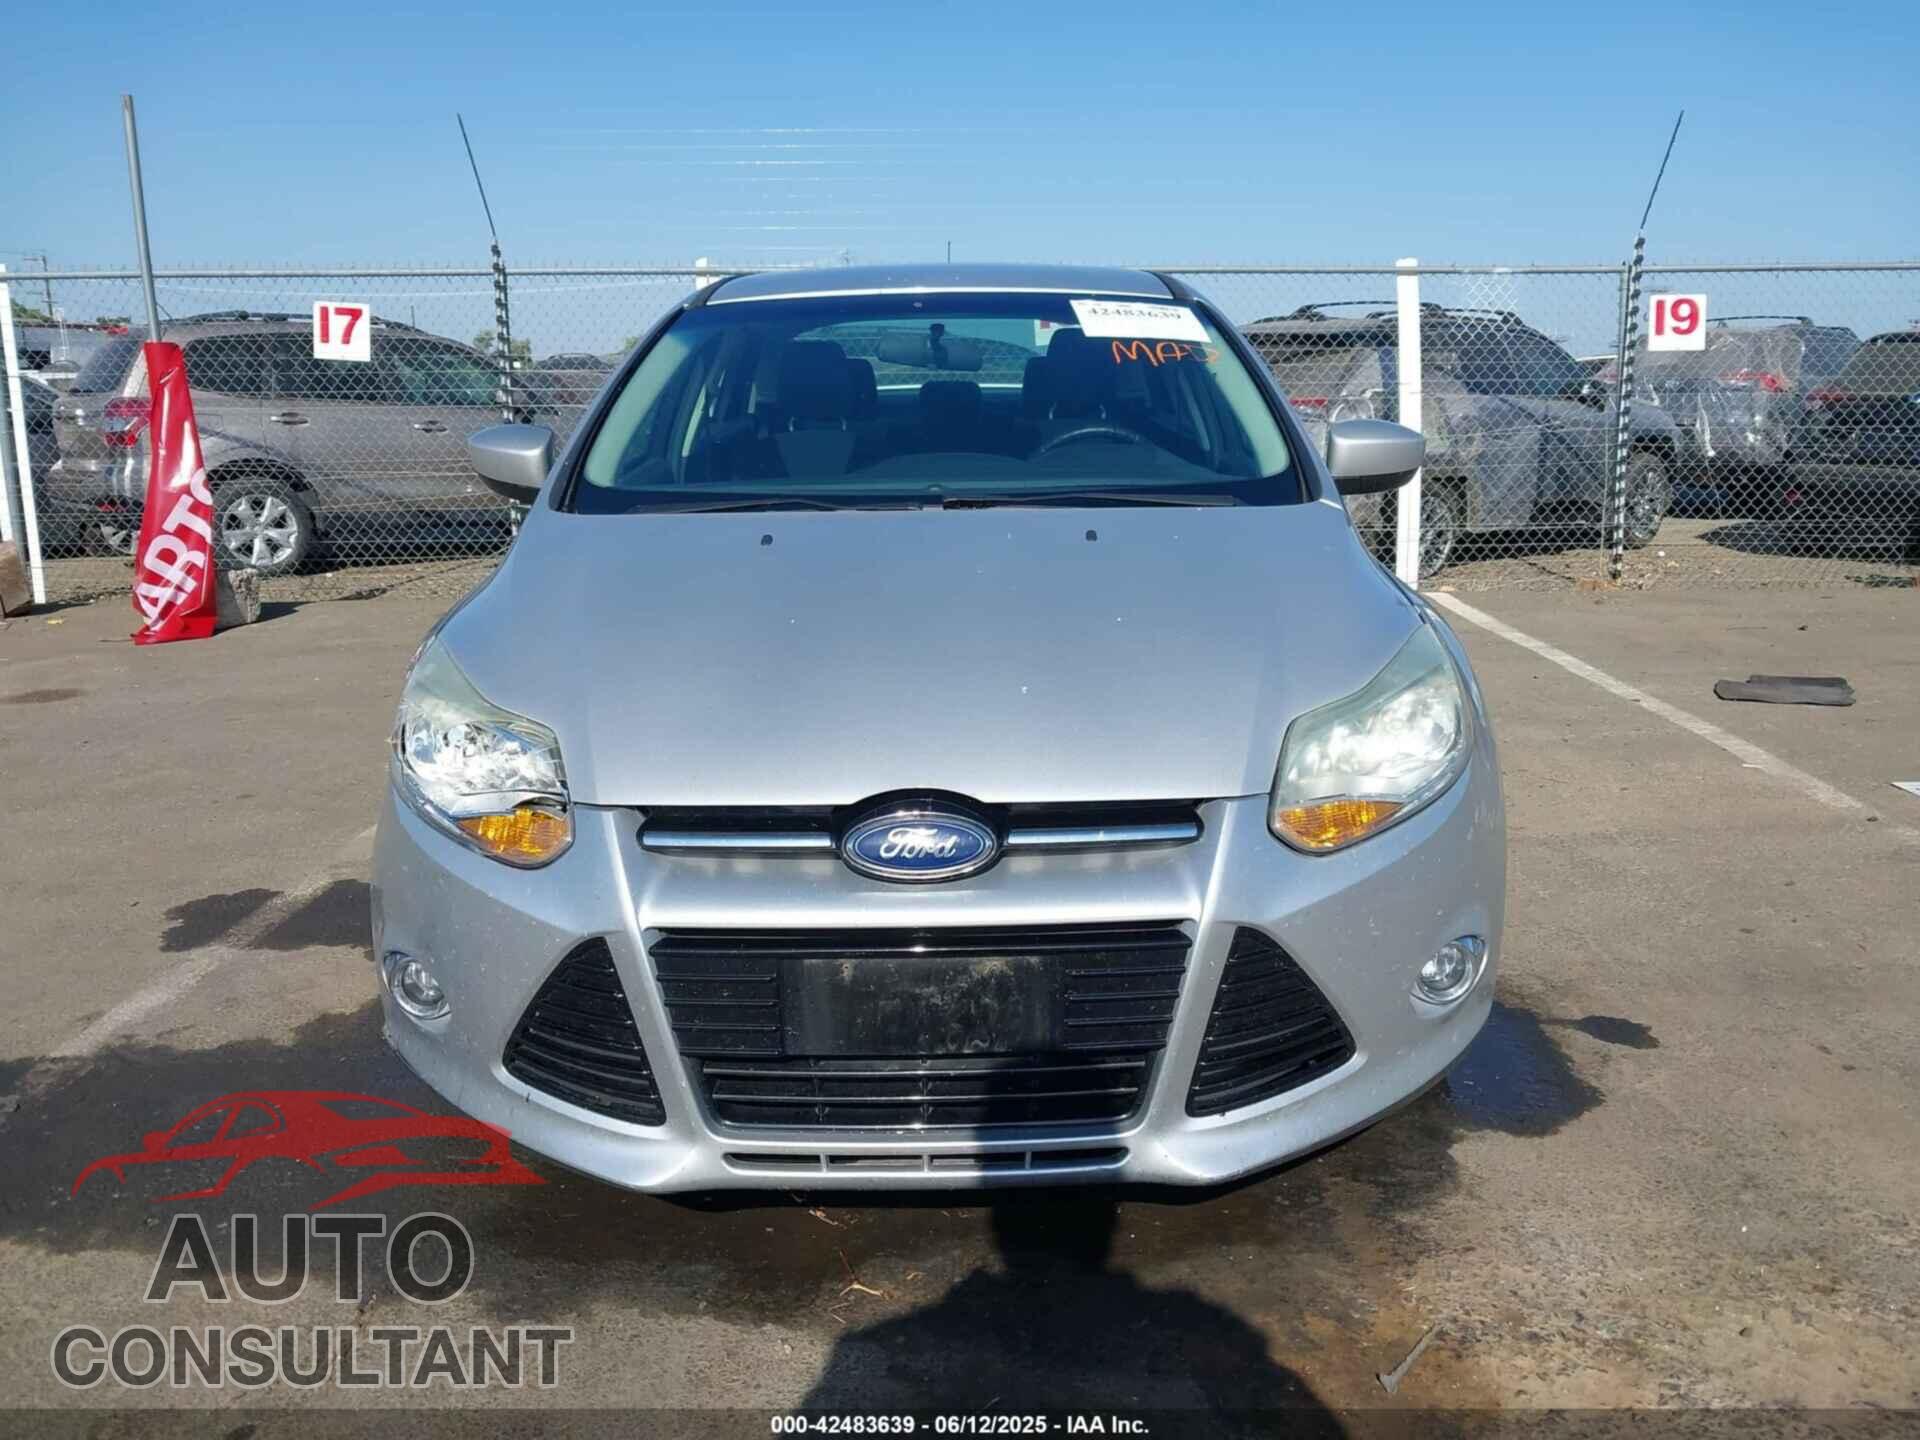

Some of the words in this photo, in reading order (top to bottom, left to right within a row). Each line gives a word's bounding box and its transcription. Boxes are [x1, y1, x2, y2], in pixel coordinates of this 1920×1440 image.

[320, 306, 363, 345] 17
[1088, 307, 1183, 320] 42483639
[1655, 298, 1699, 336] 19
[879, 826, 960, 859] Ford
